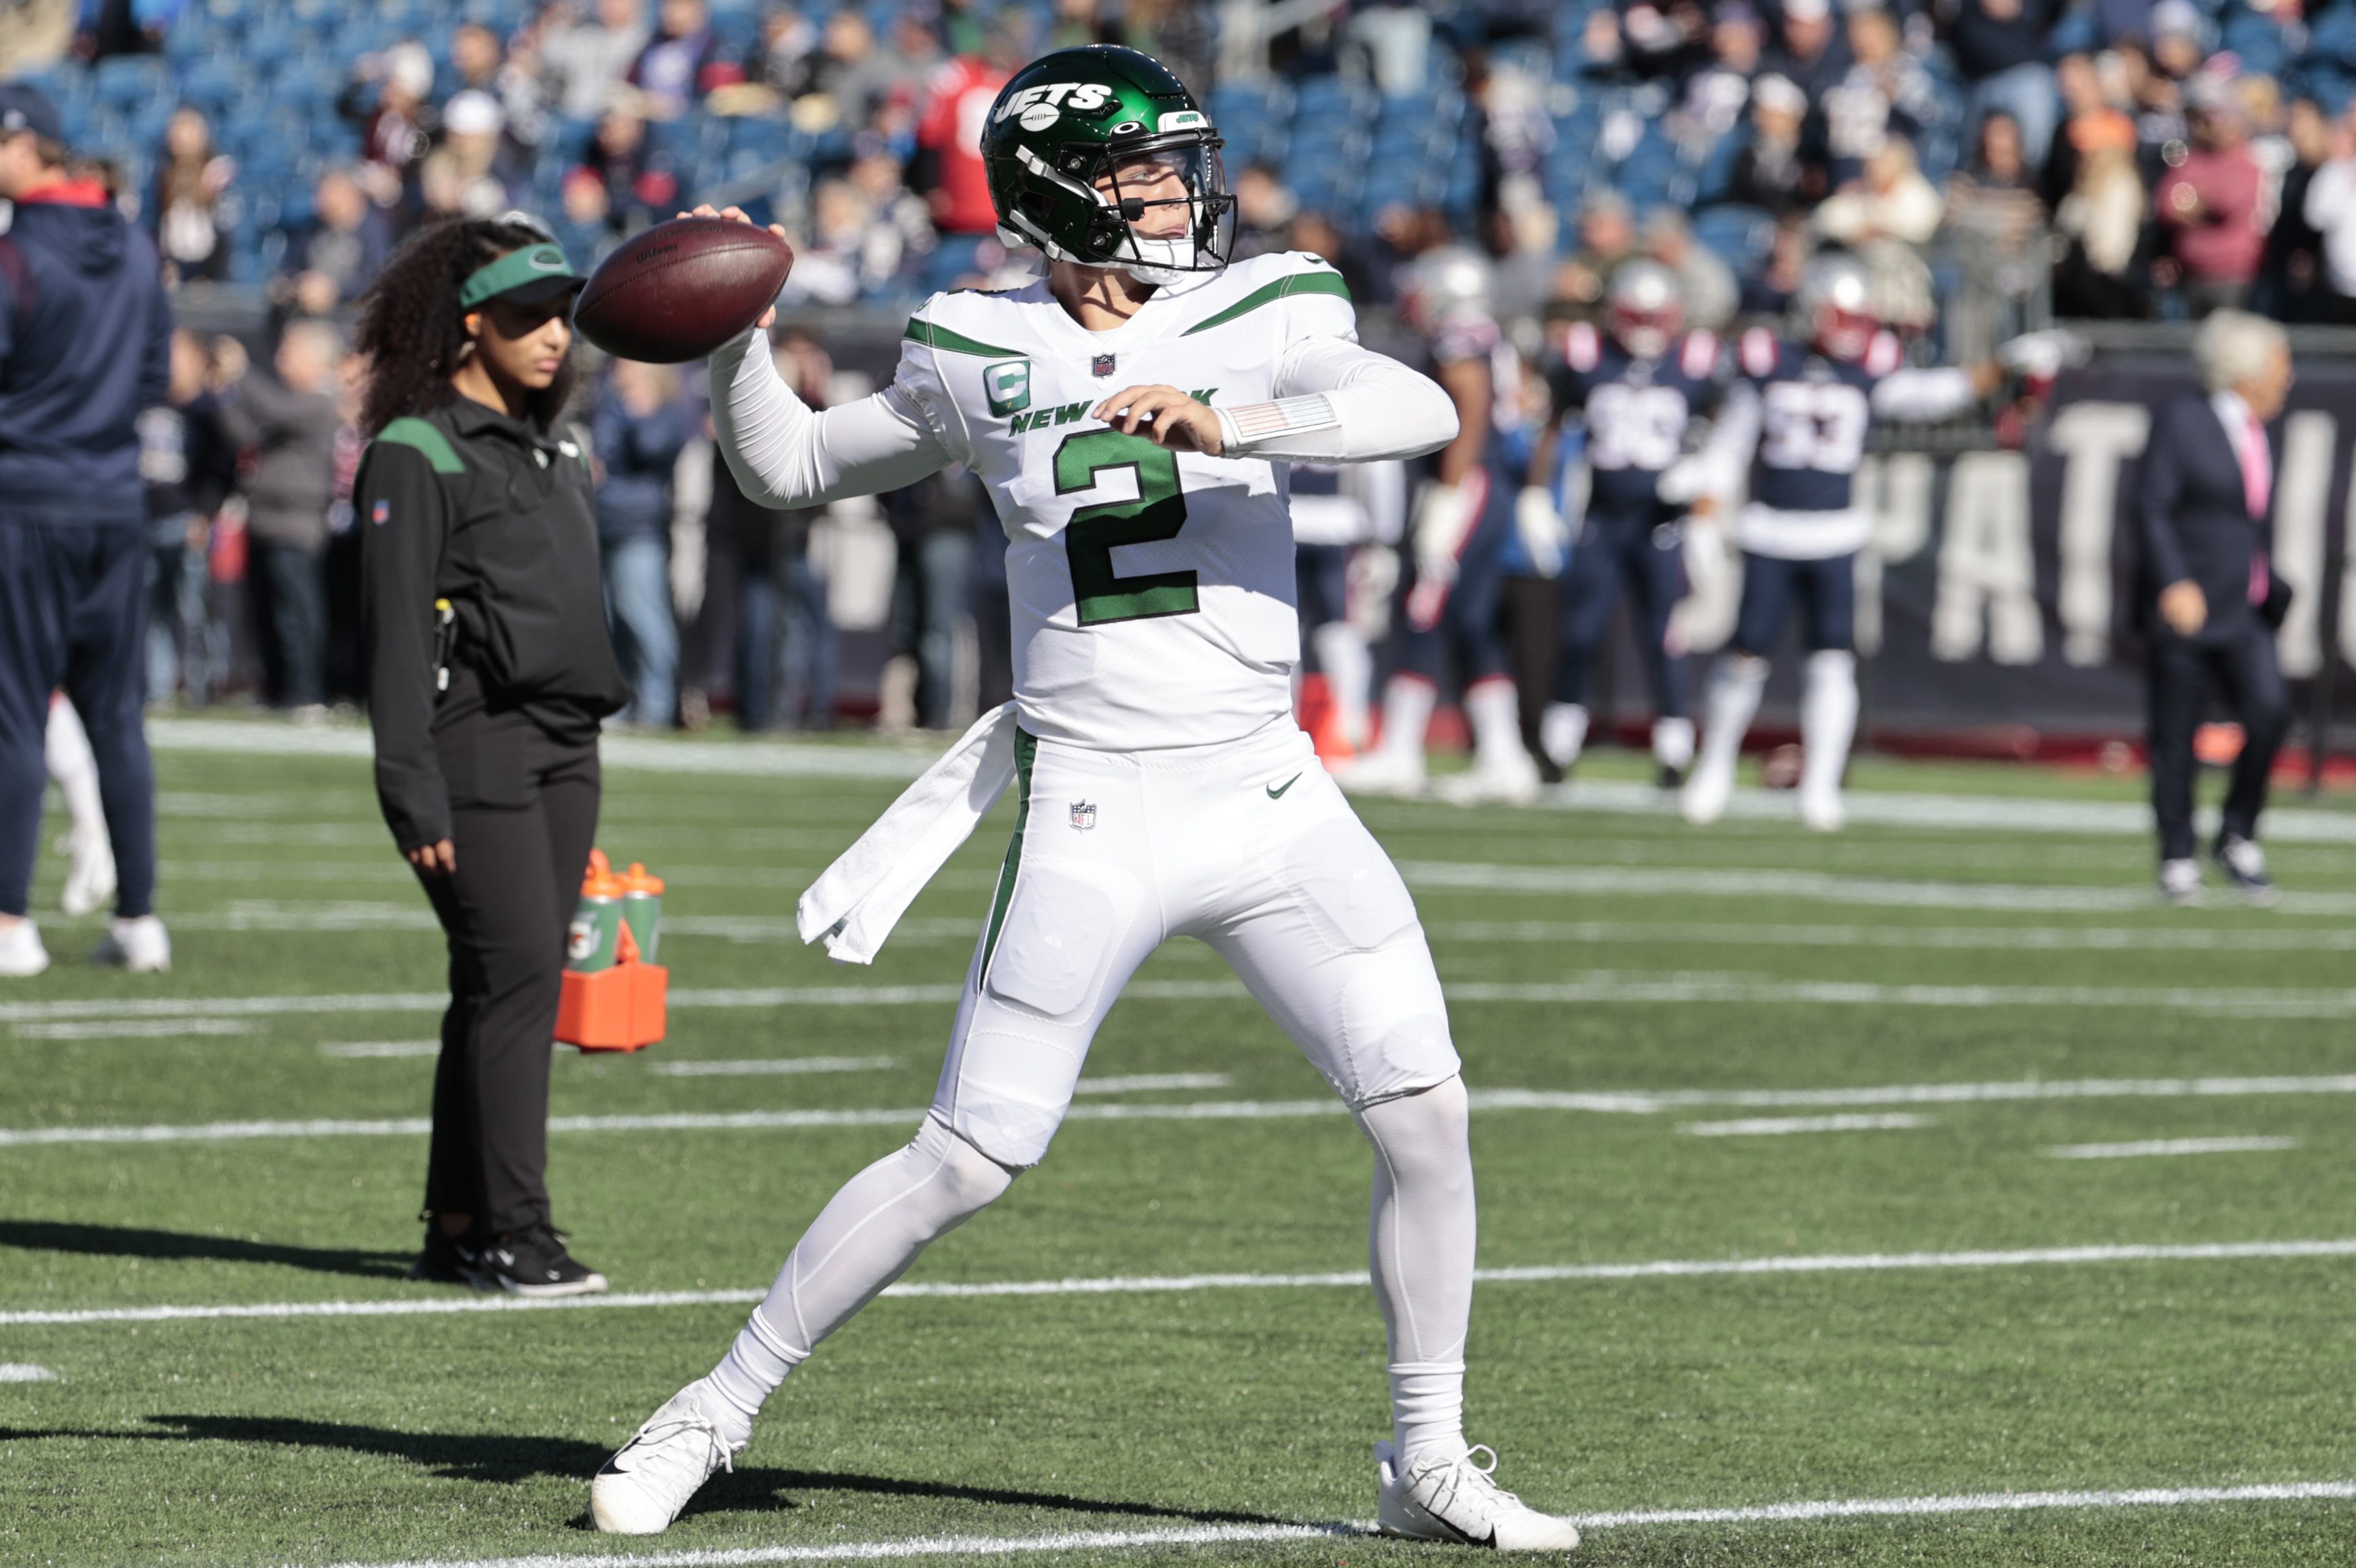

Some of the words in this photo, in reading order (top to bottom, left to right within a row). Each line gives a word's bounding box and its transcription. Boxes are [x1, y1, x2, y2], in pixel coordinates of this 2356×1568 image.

[994, 83, 1112, 124] JETS
[637, 243, 677, 262] Wilson
[988, 362, 1027, 403] C
[1009, 399, 1094, 438] NEW
[1053, 426, 1200, 627] 2
[1074, 814, 1092, 826] NFL
